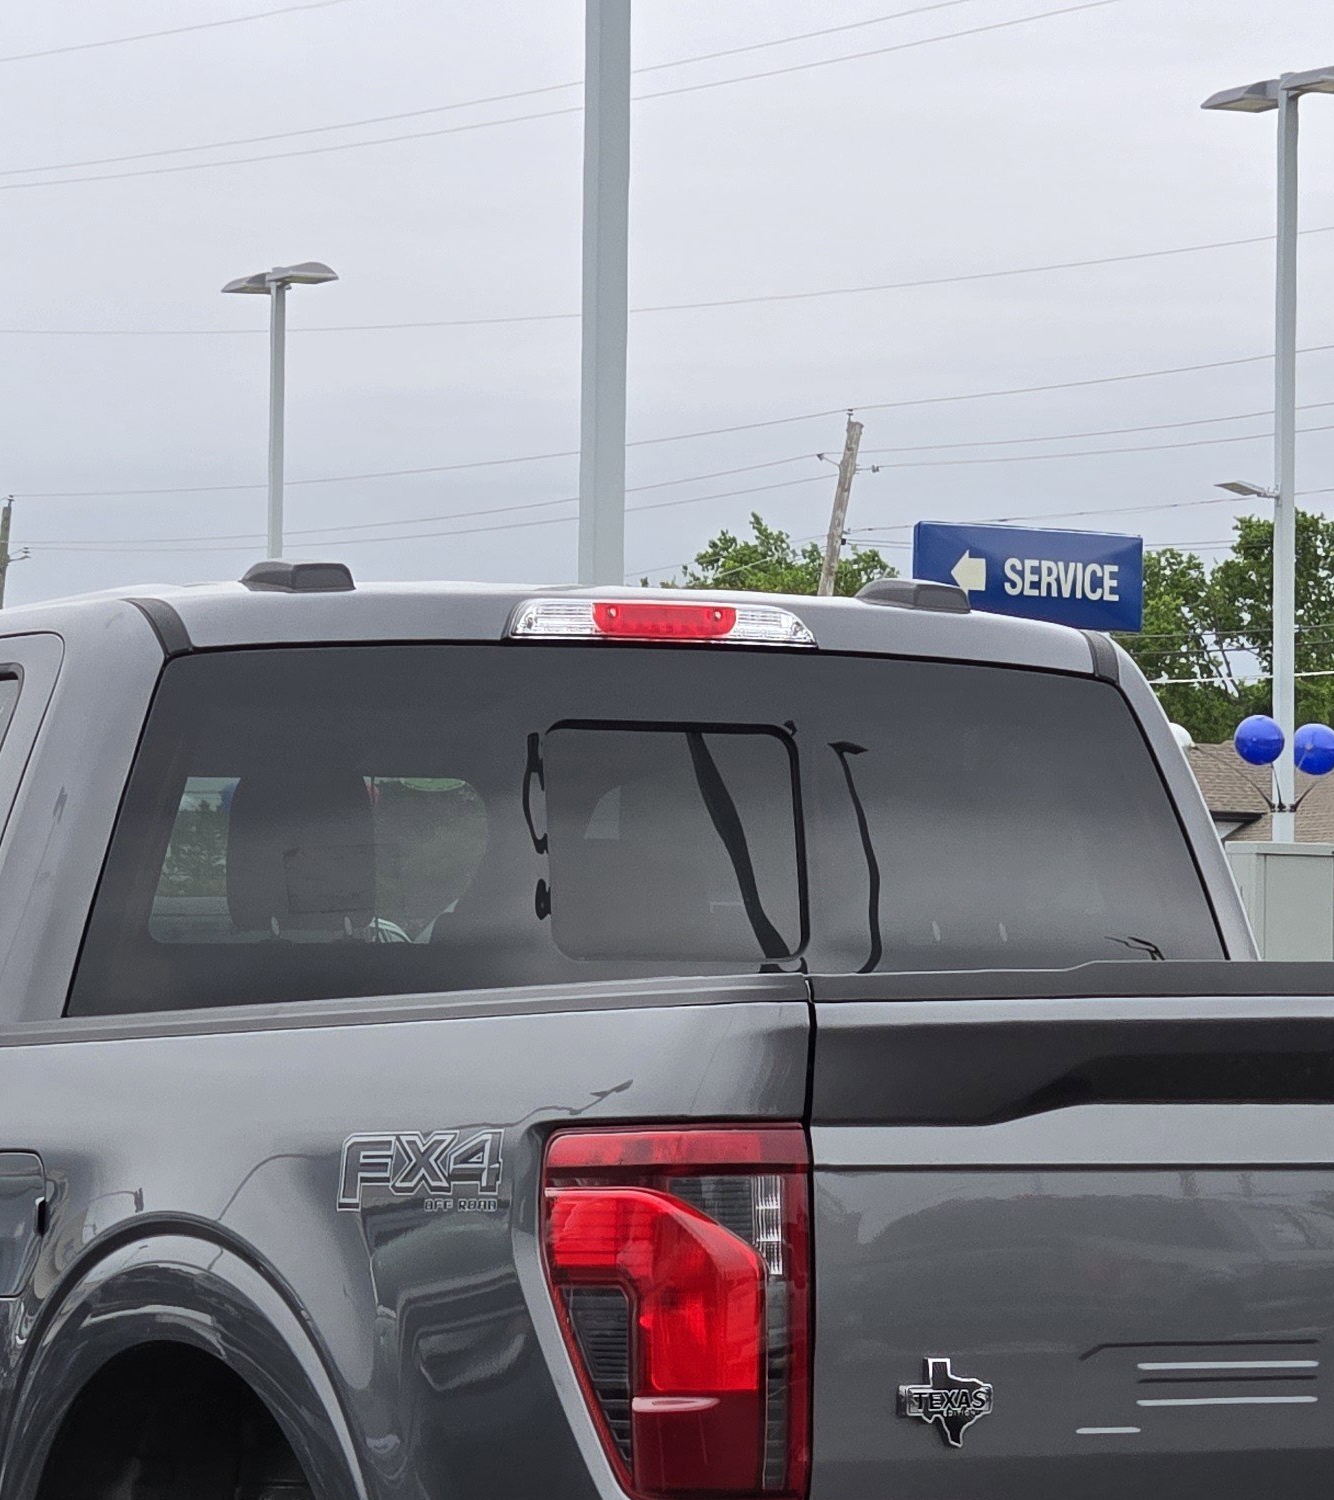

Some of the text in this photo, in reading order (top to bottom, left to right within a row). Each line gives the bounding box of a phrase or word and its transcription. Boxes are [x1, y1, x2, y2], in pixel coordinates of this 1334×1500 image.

[1004, 557, 1120, 601] SERVICE
[336, 1128, 505, 1212] FX4
[424, 1198, 498, 1212] OFF ROAD
[910, 1389, 988, 1411] TEXAS
